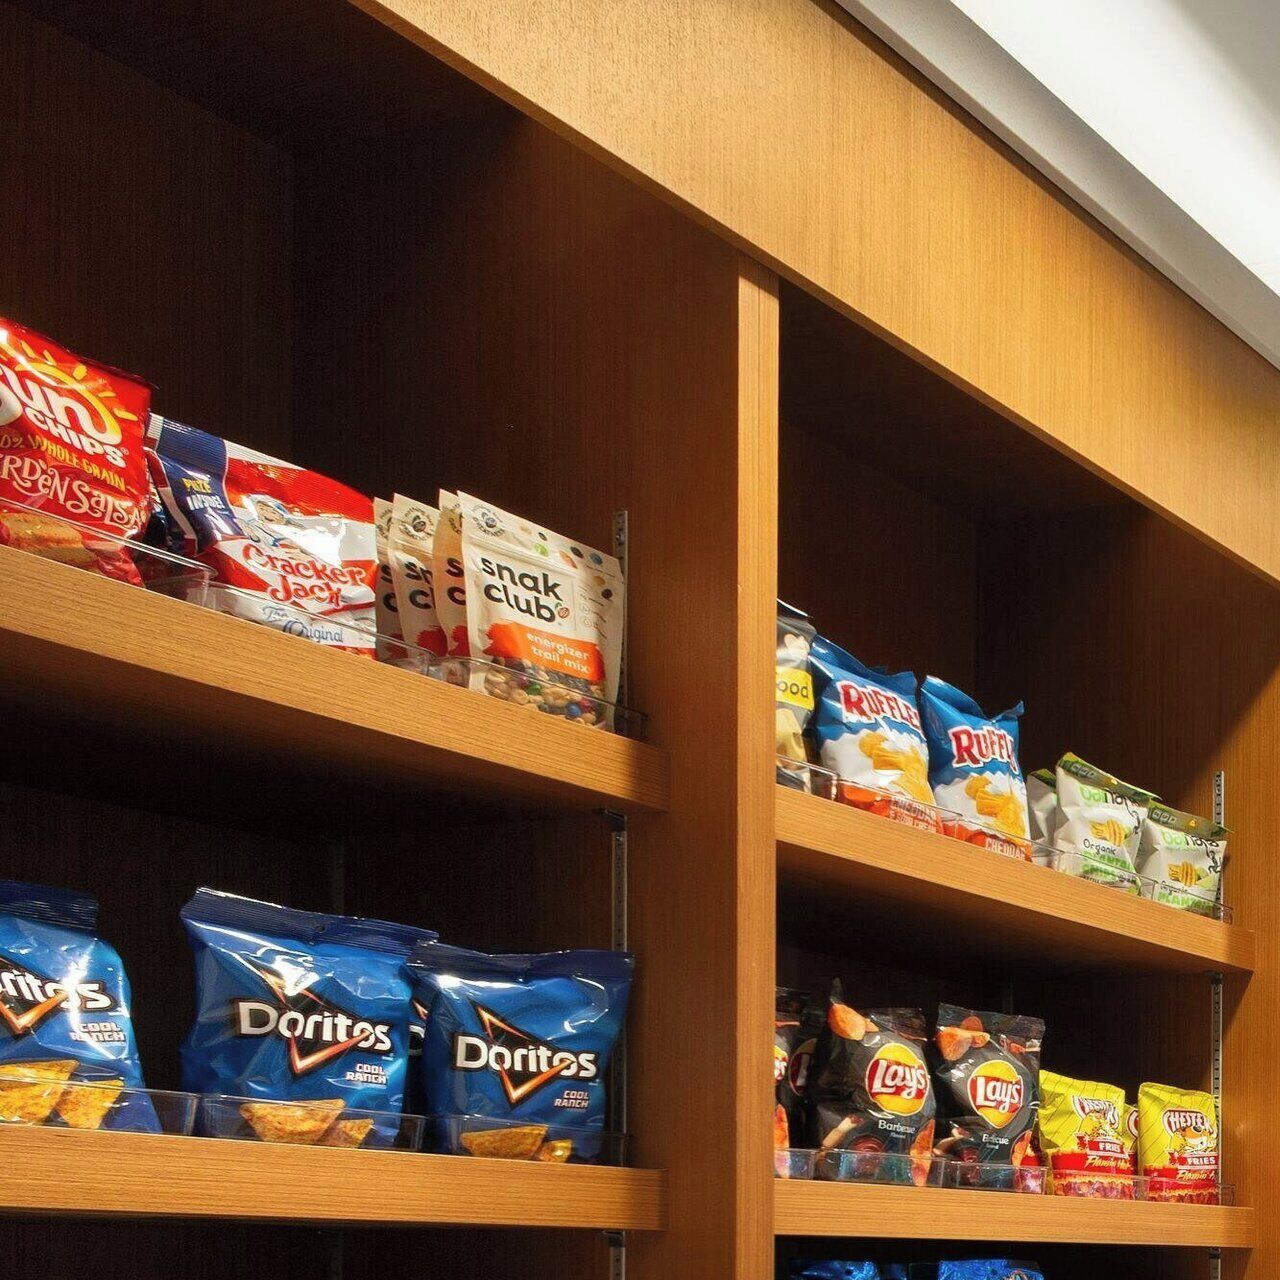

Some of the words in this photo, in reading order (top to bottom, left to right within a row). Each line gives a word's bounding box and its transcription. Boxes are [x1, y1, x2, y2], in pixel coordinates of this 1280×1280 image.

[24, 405, 127, 469] CHIPS
[82, 459, 126, 493] GRAIN
[242, 543, 367, 588] Cracker
[480, 556, 563, 602] snak
[270, 575, 342, 608] Jack
[483, 583, 557, 624] club
[526, 632, 590, 662] energizer
[532, 646, 561, 665] trail
[564, 658, 590, 674] mix
[1083, 838, 1116, 856] Organic
[238, 1001, 392, 1052] Doritos
[355, 1062, 387, 1076] COOL
[456, 1034, 598, 1078] Doritos
[345, 1071, 387, 1085] RANCH
[563, 1089, 590, 1099] COOL
[872, 1059, 926, 1100] Lay's
[975, 1076, 1021, 1112] Lay's
[554, 1096, 589, 1109] RANCH
[878, 1119, 916, 1135] Barbecue
[1186, 1156, 1215, 1165] FRIES
